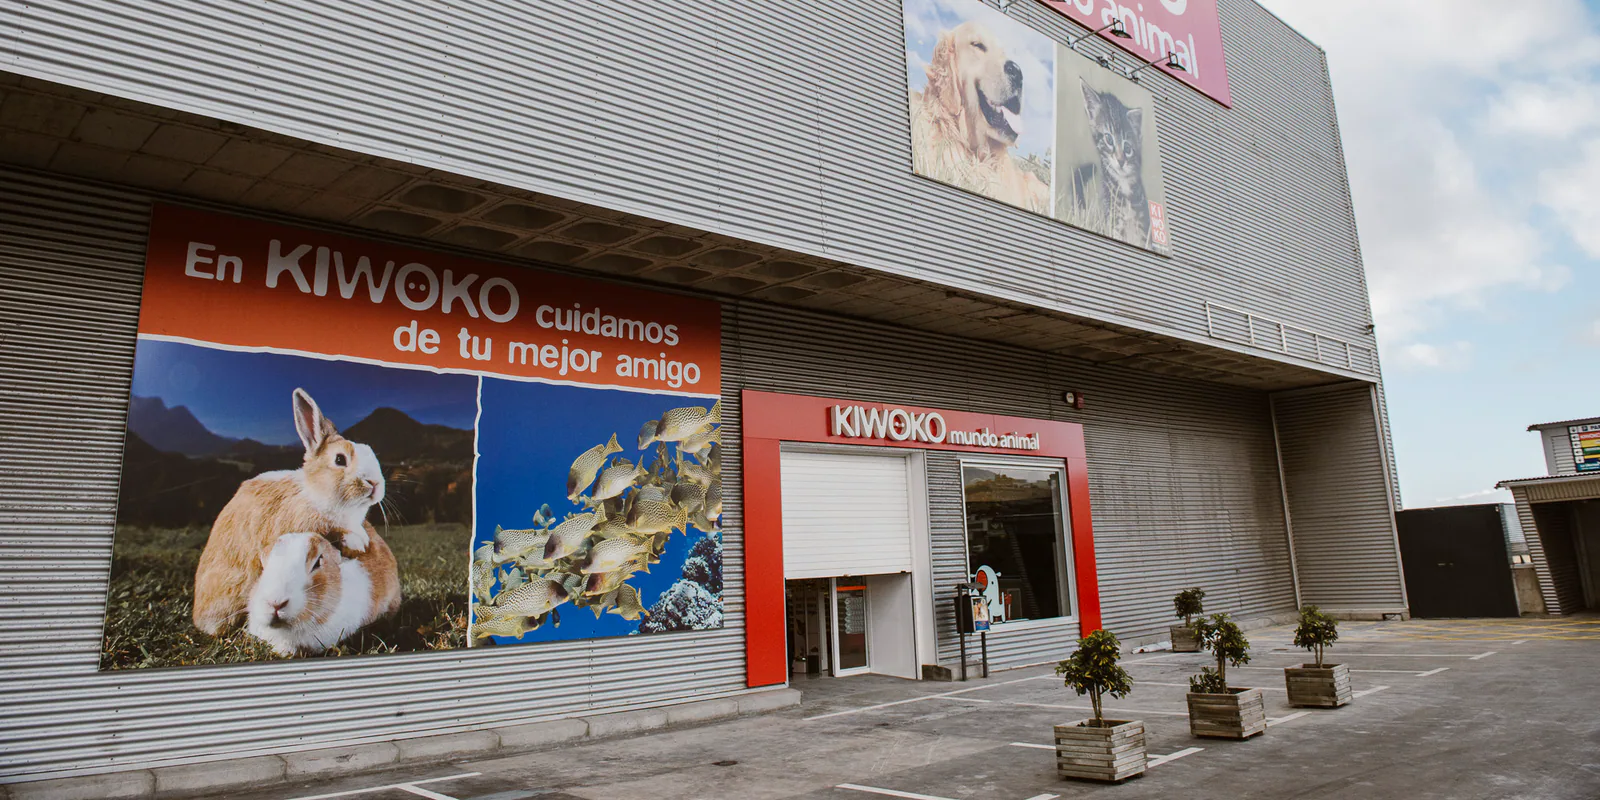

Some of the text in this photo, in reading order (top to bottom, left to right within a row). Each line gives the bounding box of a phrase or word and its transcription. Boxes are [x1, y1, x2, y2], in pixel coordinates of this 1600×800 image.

[1101, 0, 1199, 79] animal
[185, 239, 679, 346] En KIWOKO cuidamos
[393, 320, 700, 388] de tu mejor amigo
[832, 404, 1040, 450] KIWOKO mundo animal
